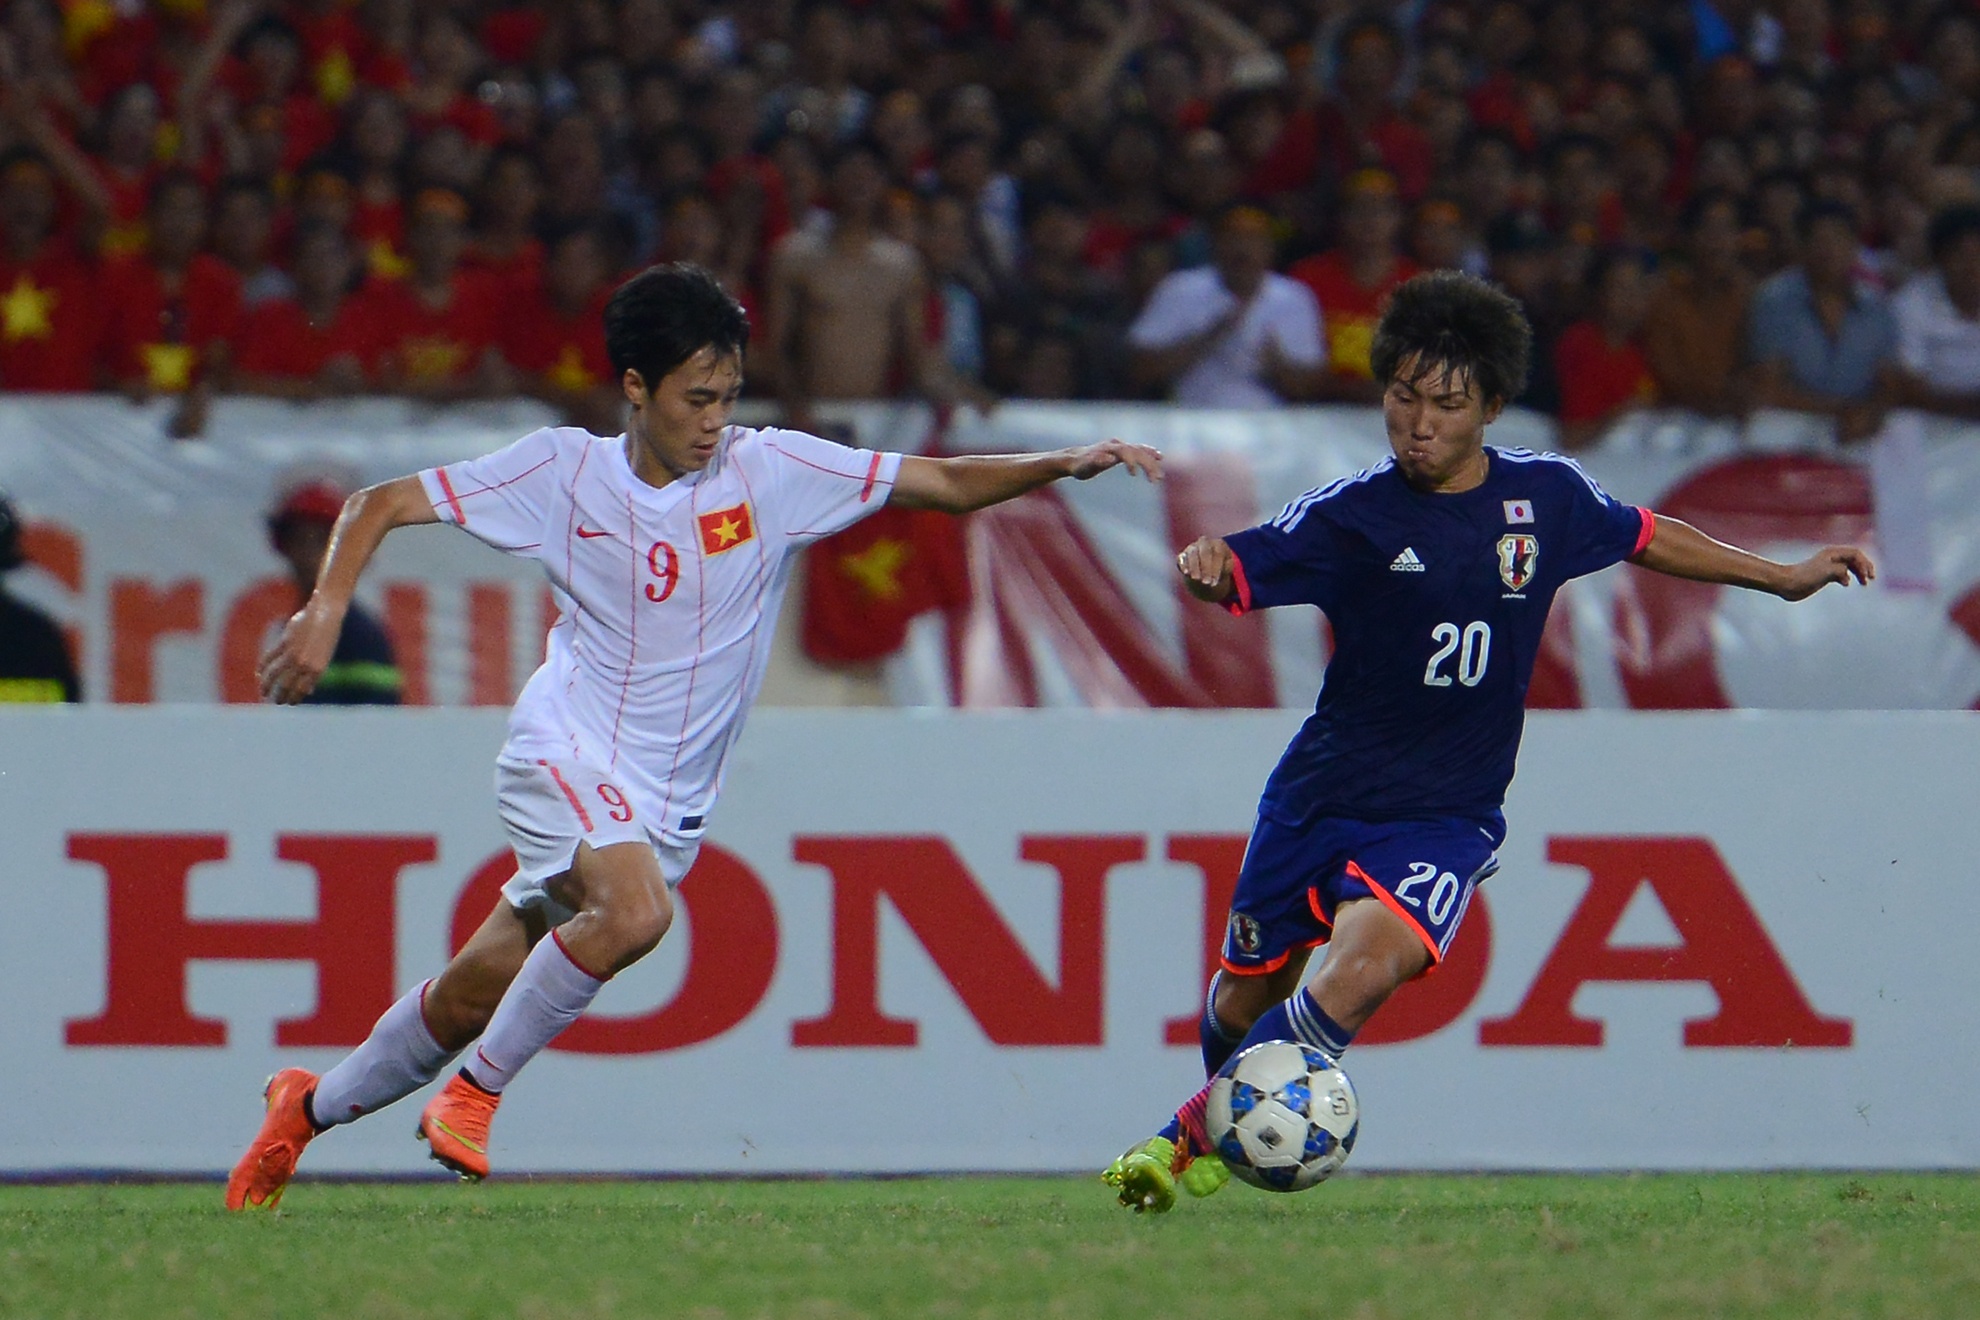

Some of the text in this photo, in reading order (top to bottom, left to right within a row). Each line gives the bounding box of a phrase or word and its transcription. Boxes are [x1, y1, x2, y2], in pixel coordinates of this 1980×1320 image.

[644, 540, 679, 603] 9
[1423, 620, 1491, 687] 20
[596, 783, 633, 822] 9
[1394, 861, 1459, 926] 20
